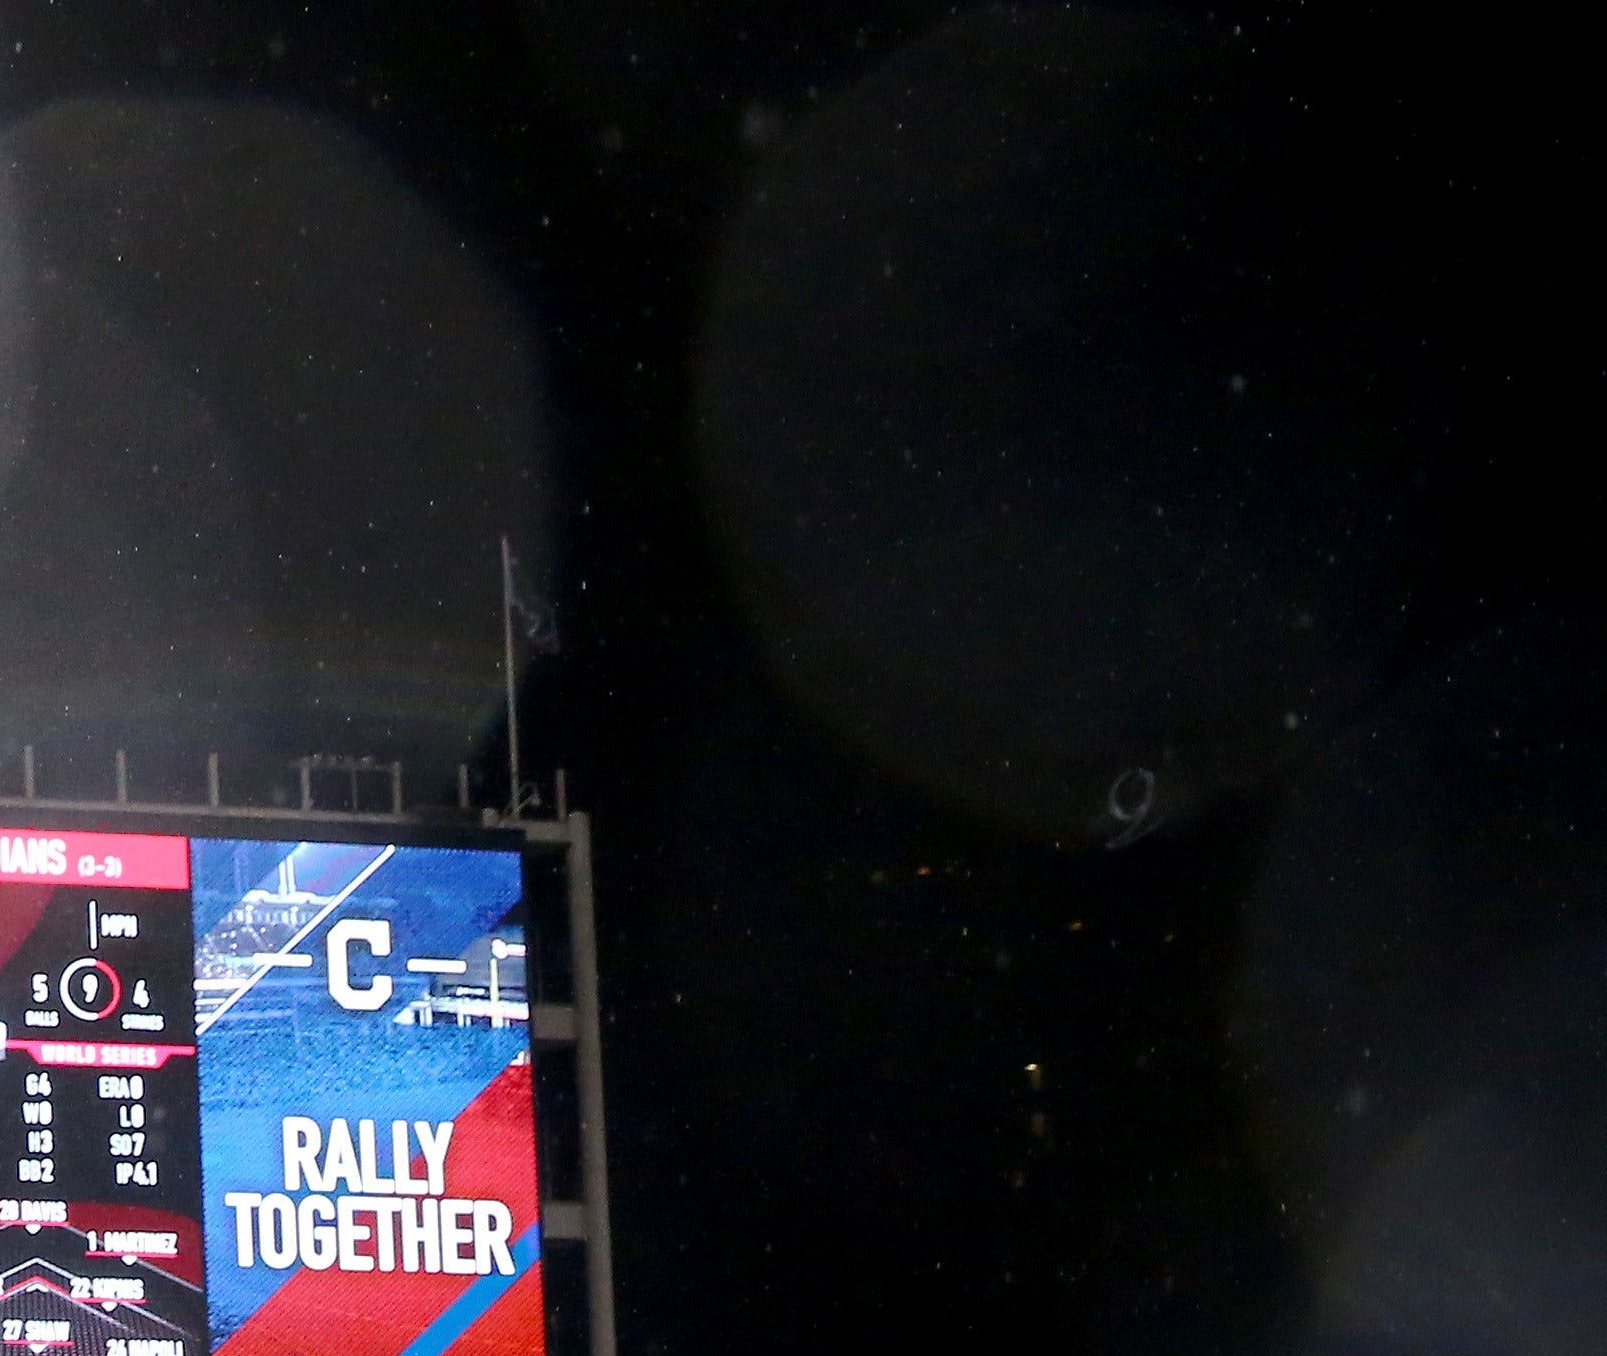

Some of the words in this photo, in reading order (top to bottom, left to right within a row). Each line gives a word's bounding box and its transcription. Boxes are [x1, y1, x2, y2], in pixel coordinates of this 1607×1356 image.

[79, 856, 121, 876] (3-3)
[33, 975, 48, 1002] 5
[83, 975, 97, 1002] 9
[100, 1045, 157, 1067] SERIES
[283, 1117, 453, 1195] RALLY
[225, 1193, 515, 1274] TOGETHER
